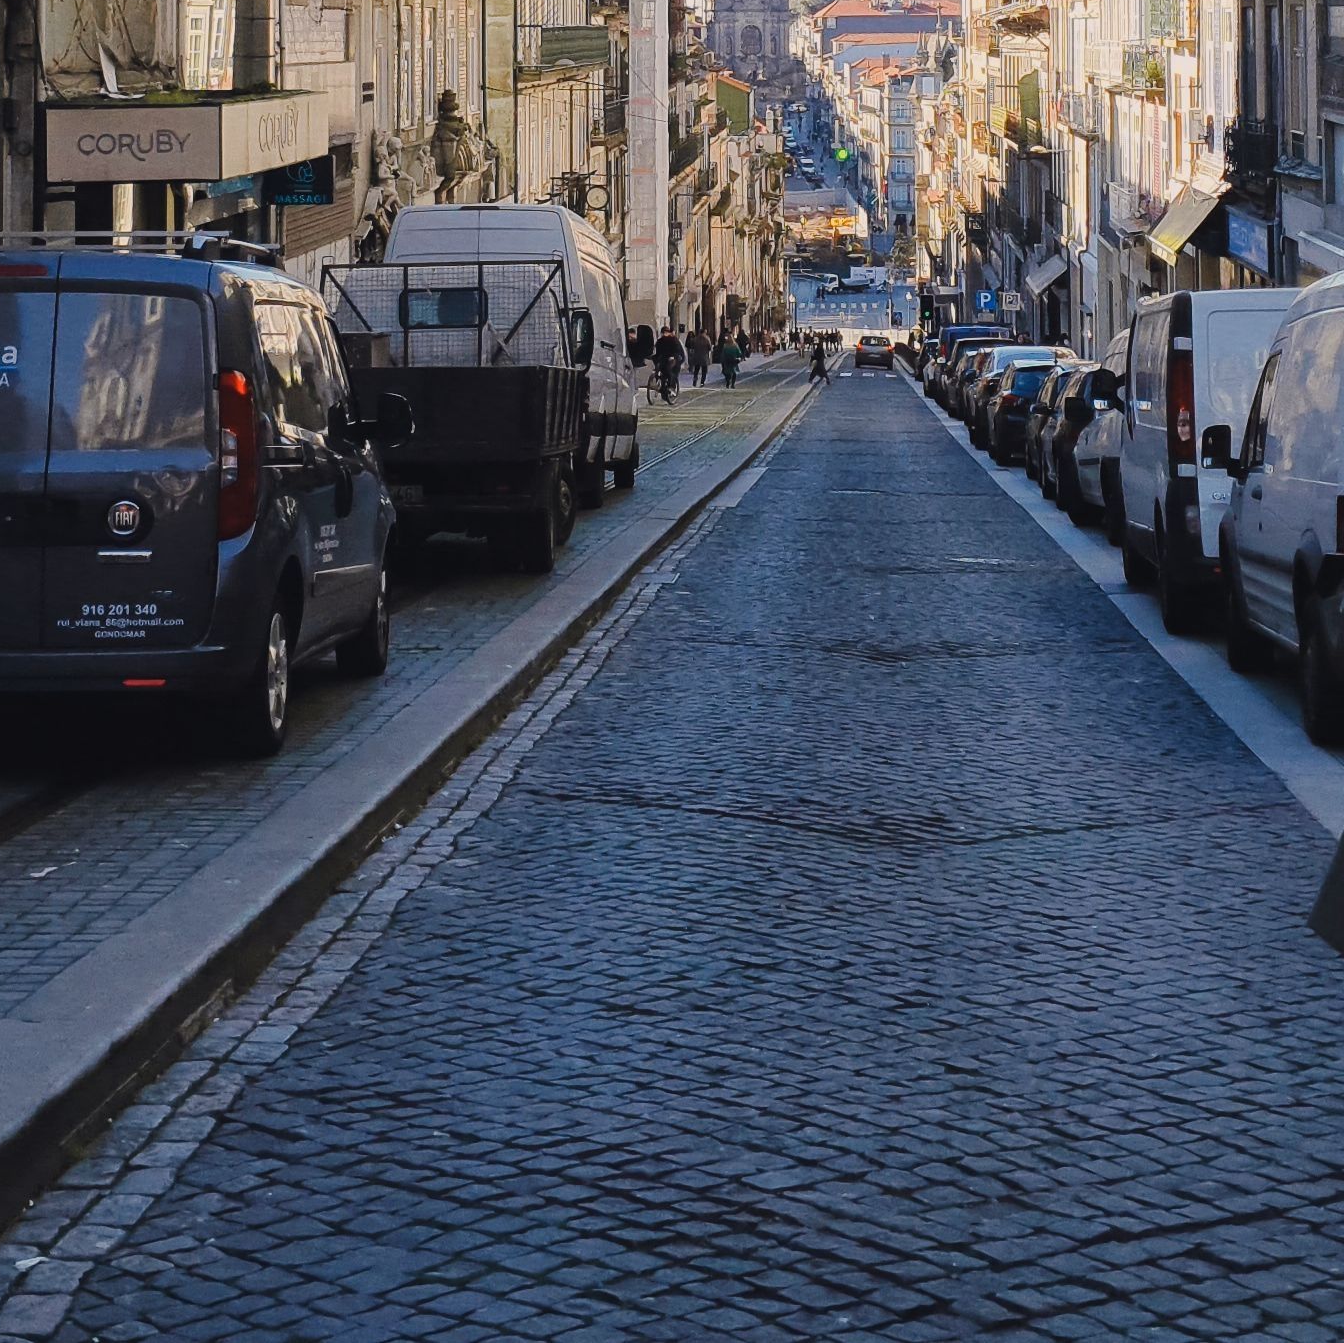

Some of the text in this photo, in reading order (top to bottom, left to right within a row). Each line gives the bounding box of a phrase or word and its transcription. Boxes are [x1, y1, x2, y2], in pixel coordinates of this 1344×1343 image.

[258, 104, 300, 162] CORUBY
[76, 129, 192, 162] CORUBY
[980, 292, 992, 308] P
[115, 510, 135, 527] FIAT
[81, 603, 158, 616] 916 201 340
